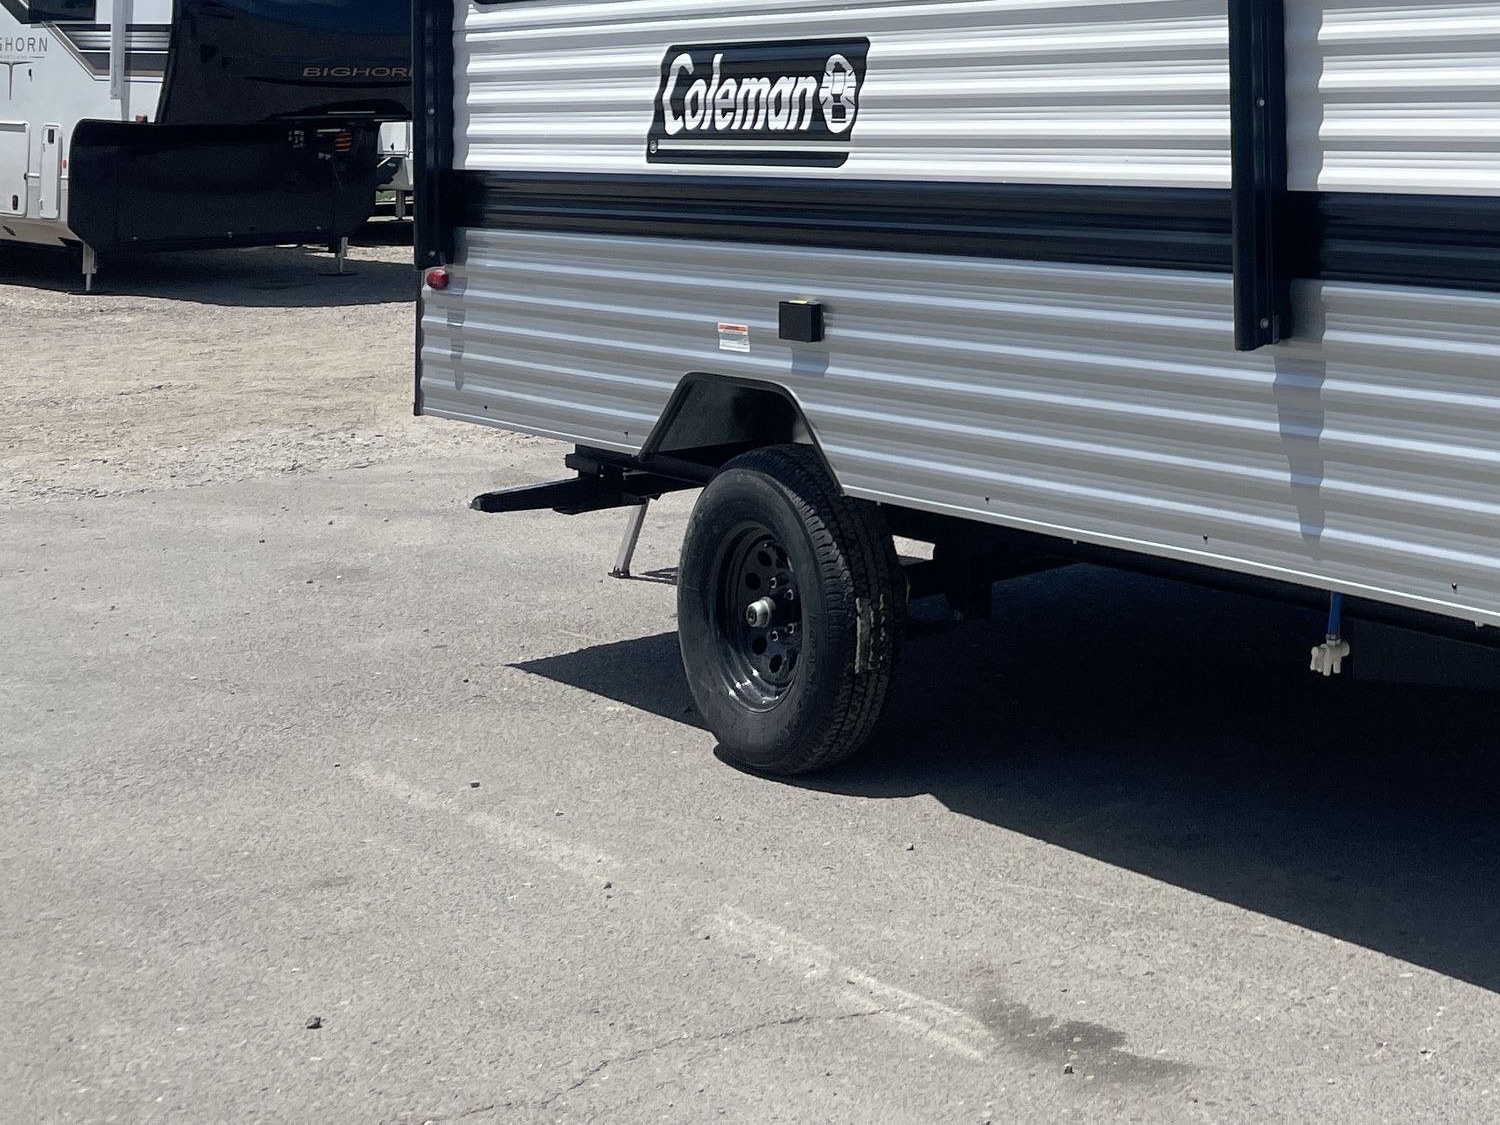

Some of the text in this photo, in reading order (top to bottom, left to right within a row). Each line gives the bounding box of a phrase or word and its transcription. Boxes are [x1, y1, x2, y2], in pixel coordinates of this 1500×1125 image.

[0, 37, 48, 52] HORN
[302, 67, 412, 77] BIGHOR
[662, 53, 818, 135] Coleman
